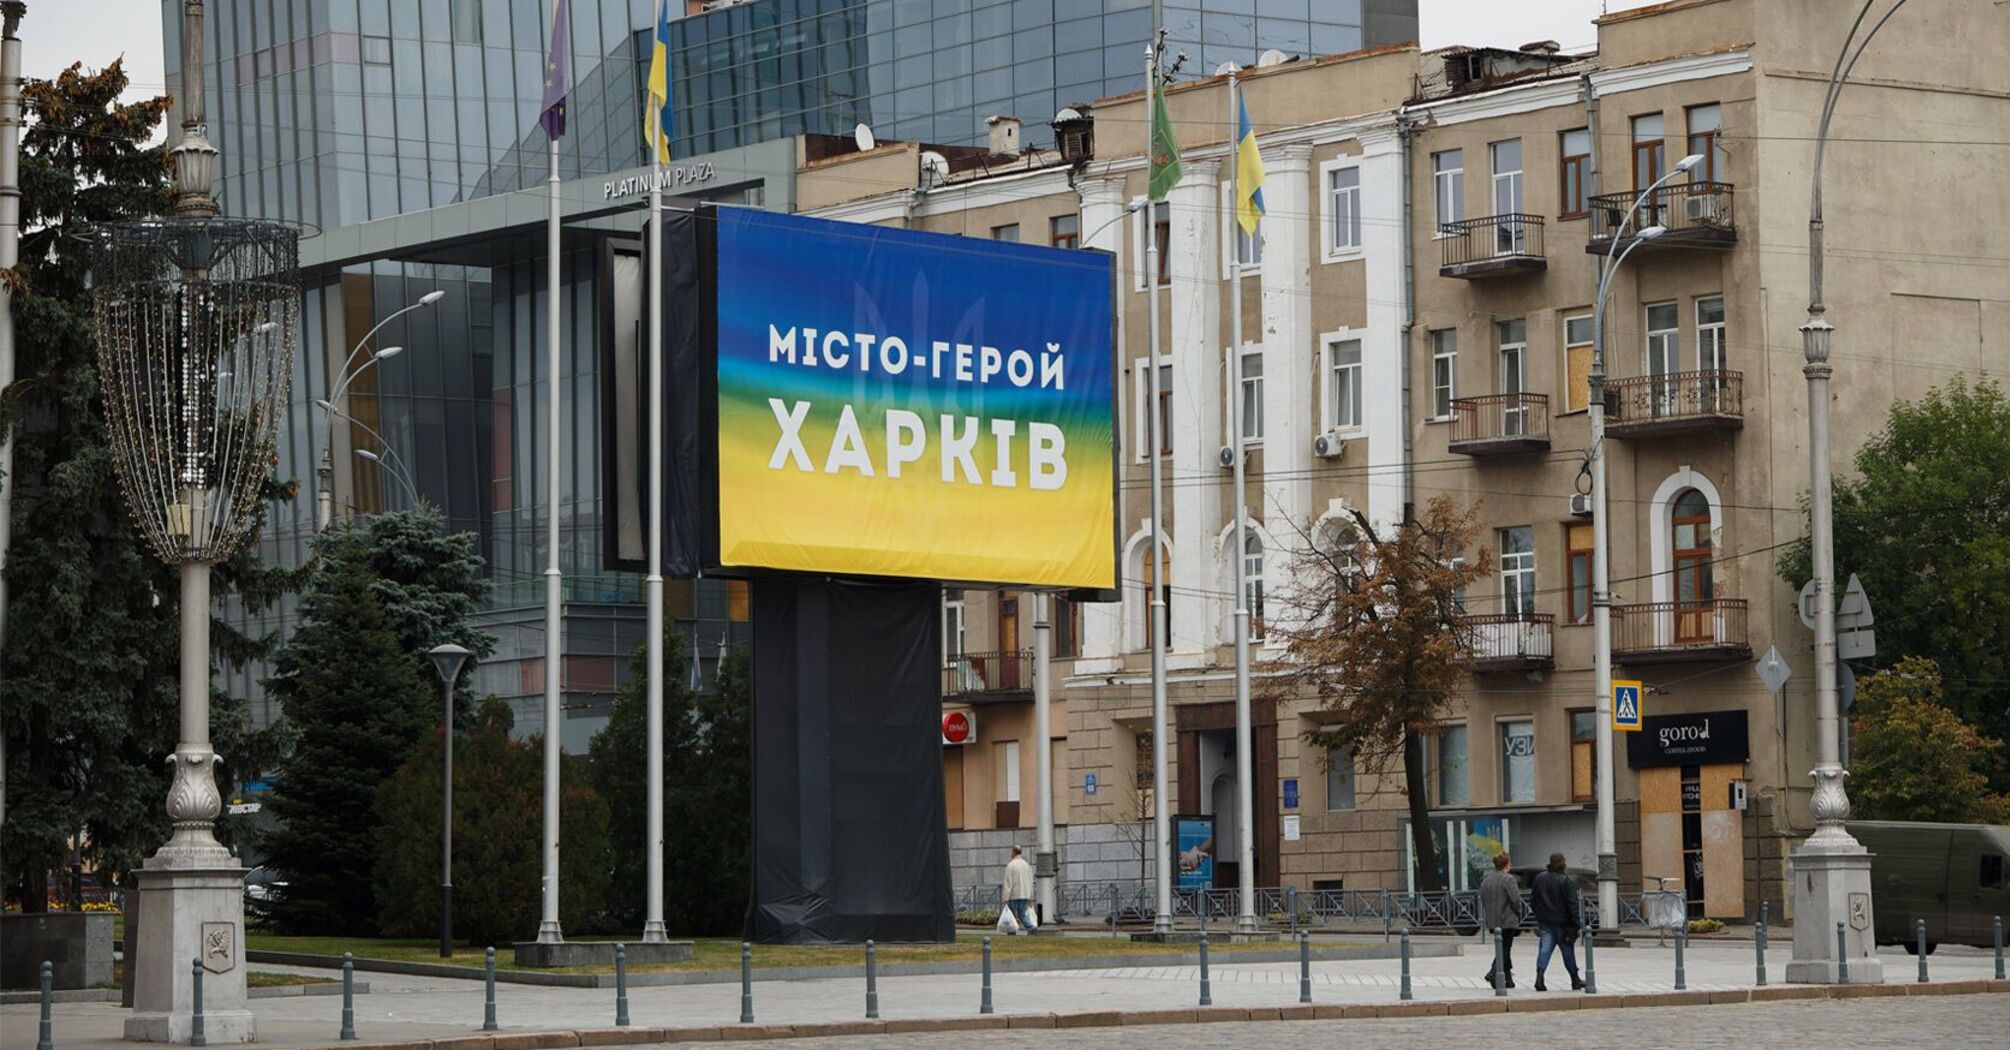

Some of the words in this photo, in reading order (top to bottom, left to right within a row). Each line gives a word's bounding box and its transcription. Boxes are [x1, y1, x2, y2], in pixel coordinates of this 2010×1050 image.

[675, 162, 716, 184] PLAZA
[769, 323, 1064, 390] МІСТО-ГЕРОЙ
[768, 398, 1067, 490] ХАРКІВ
[1659, 718, 1710, 747] gorod
